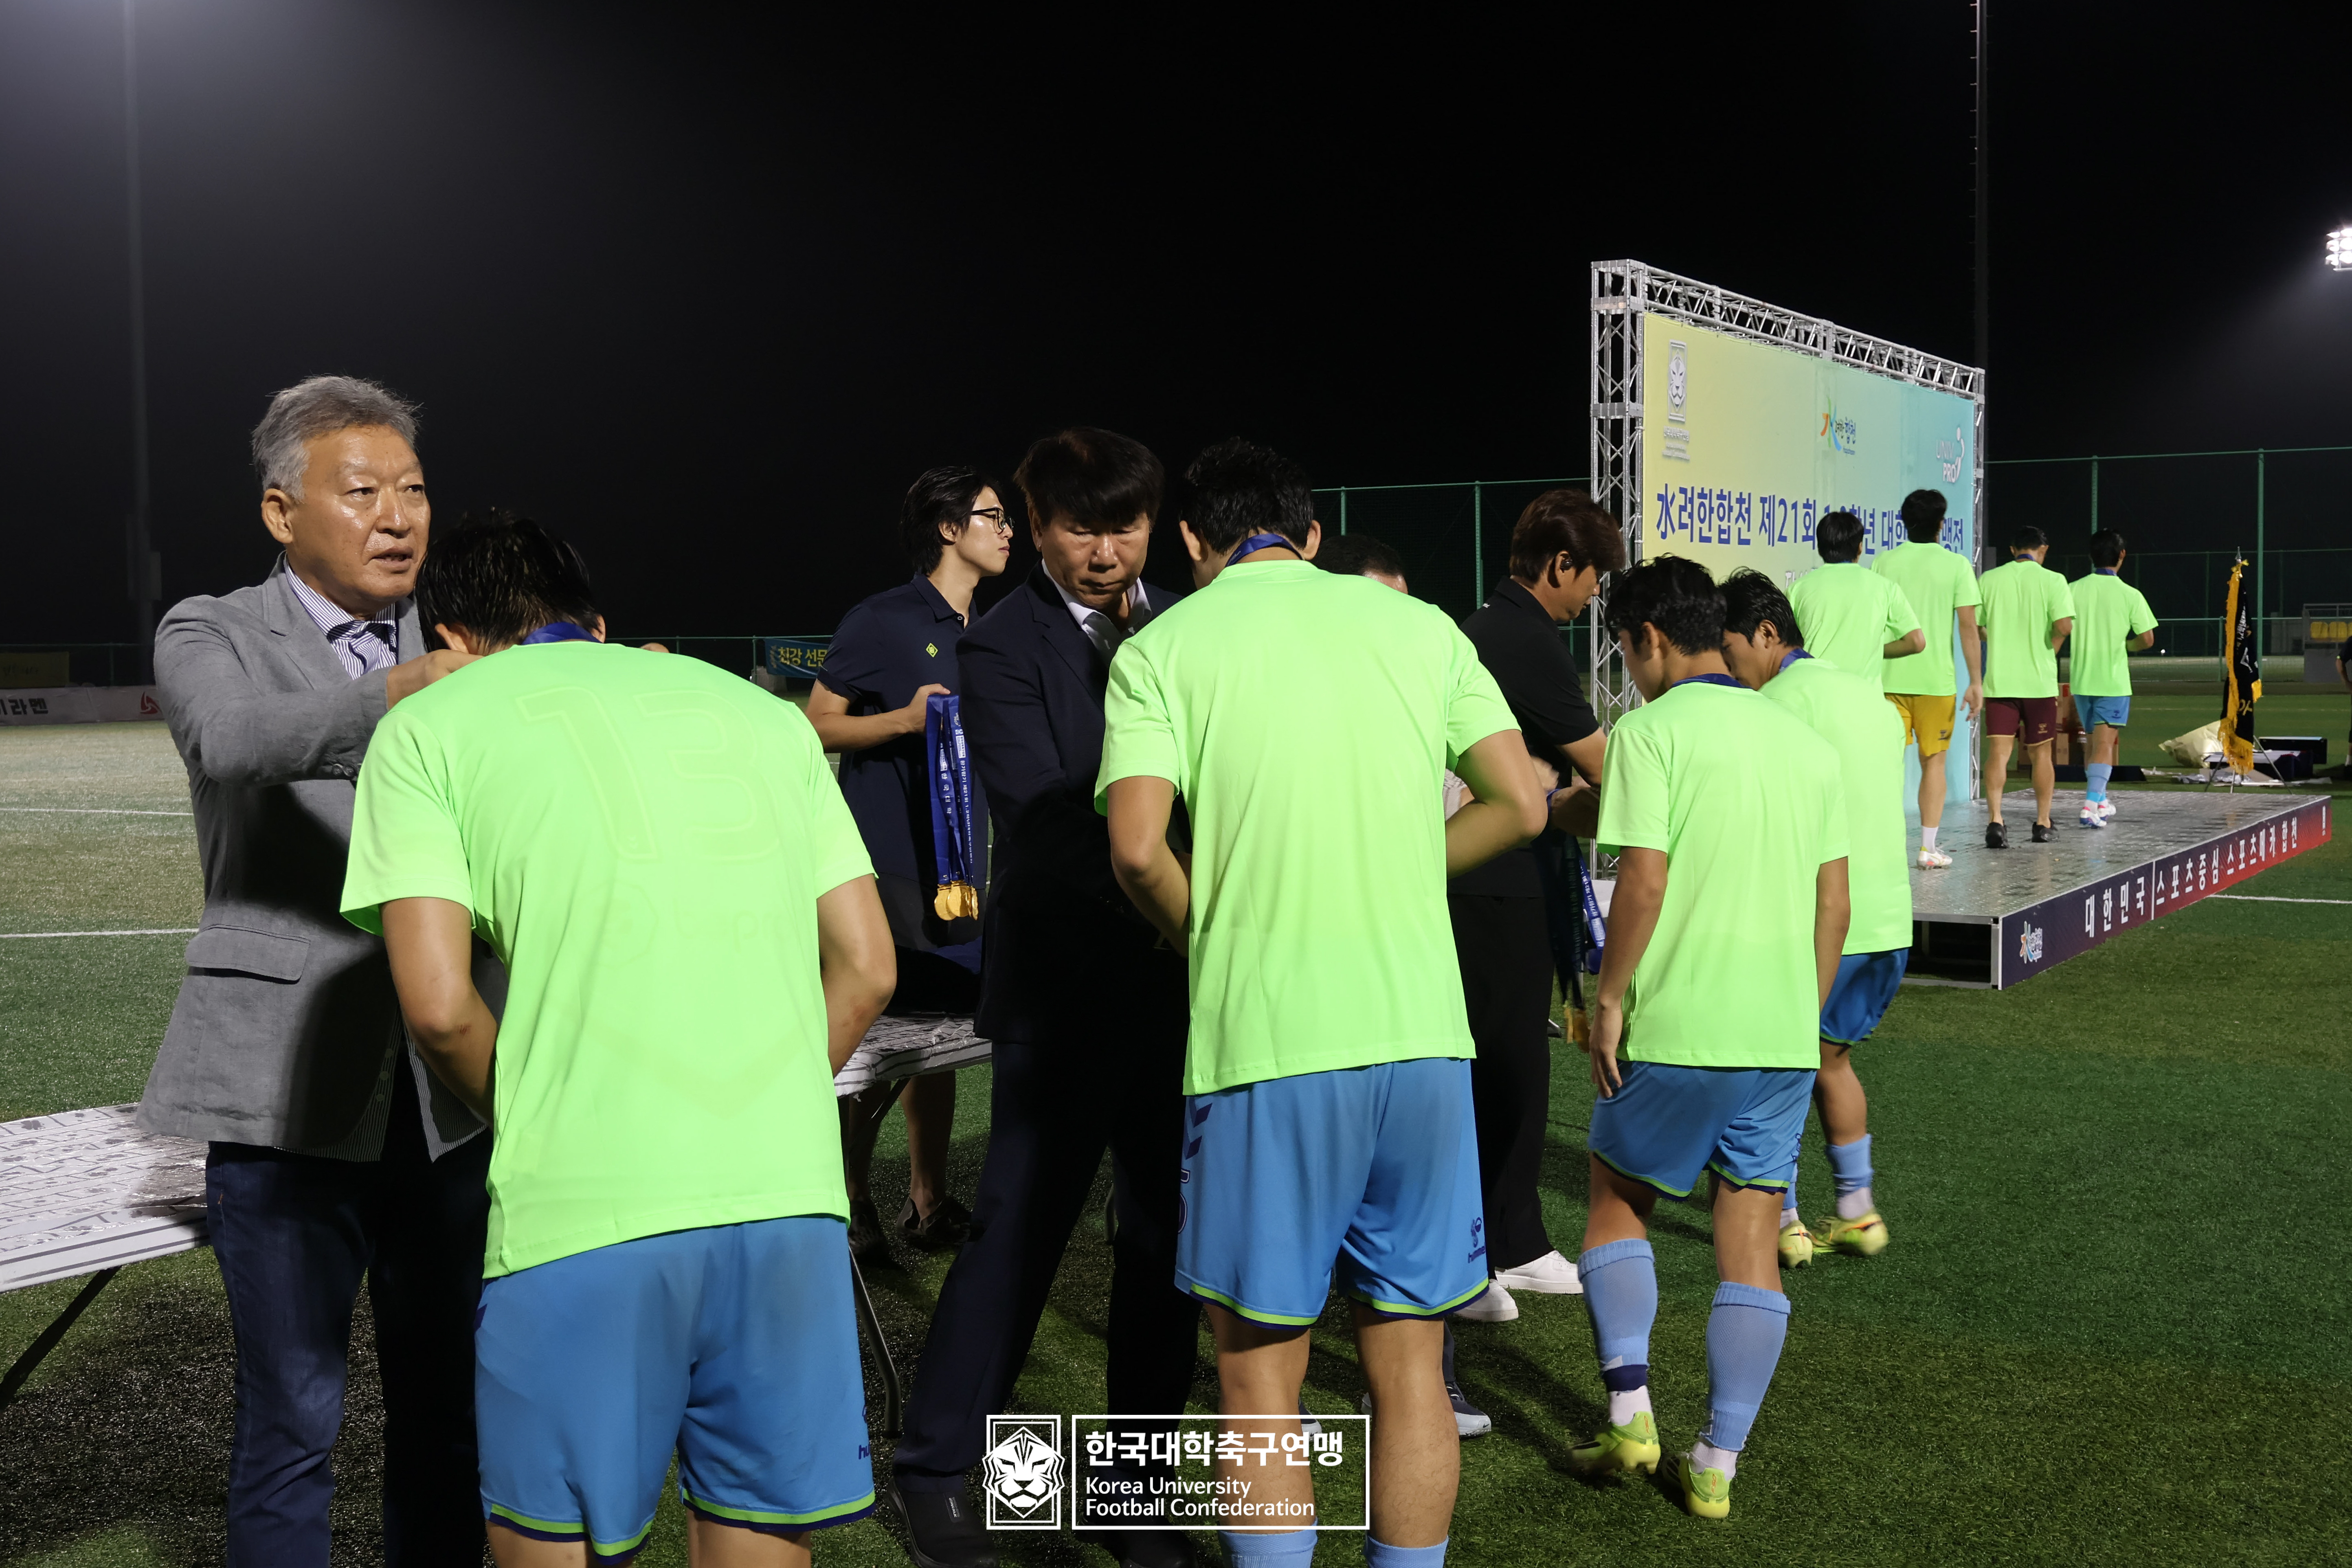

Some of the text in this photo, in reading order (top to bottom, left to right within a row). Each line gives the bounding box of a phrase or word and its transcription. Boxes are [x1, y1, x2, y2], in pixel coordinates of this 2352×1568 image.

[1943, 462, 1956, 483] PRO
[1656, 483, 1751, 545] 水려한합천
[1759, 494, 1816, 550] 제21회
[2085, 817, 2297, 938] 대한민국 스포츠중심 스포츠메카 합천
